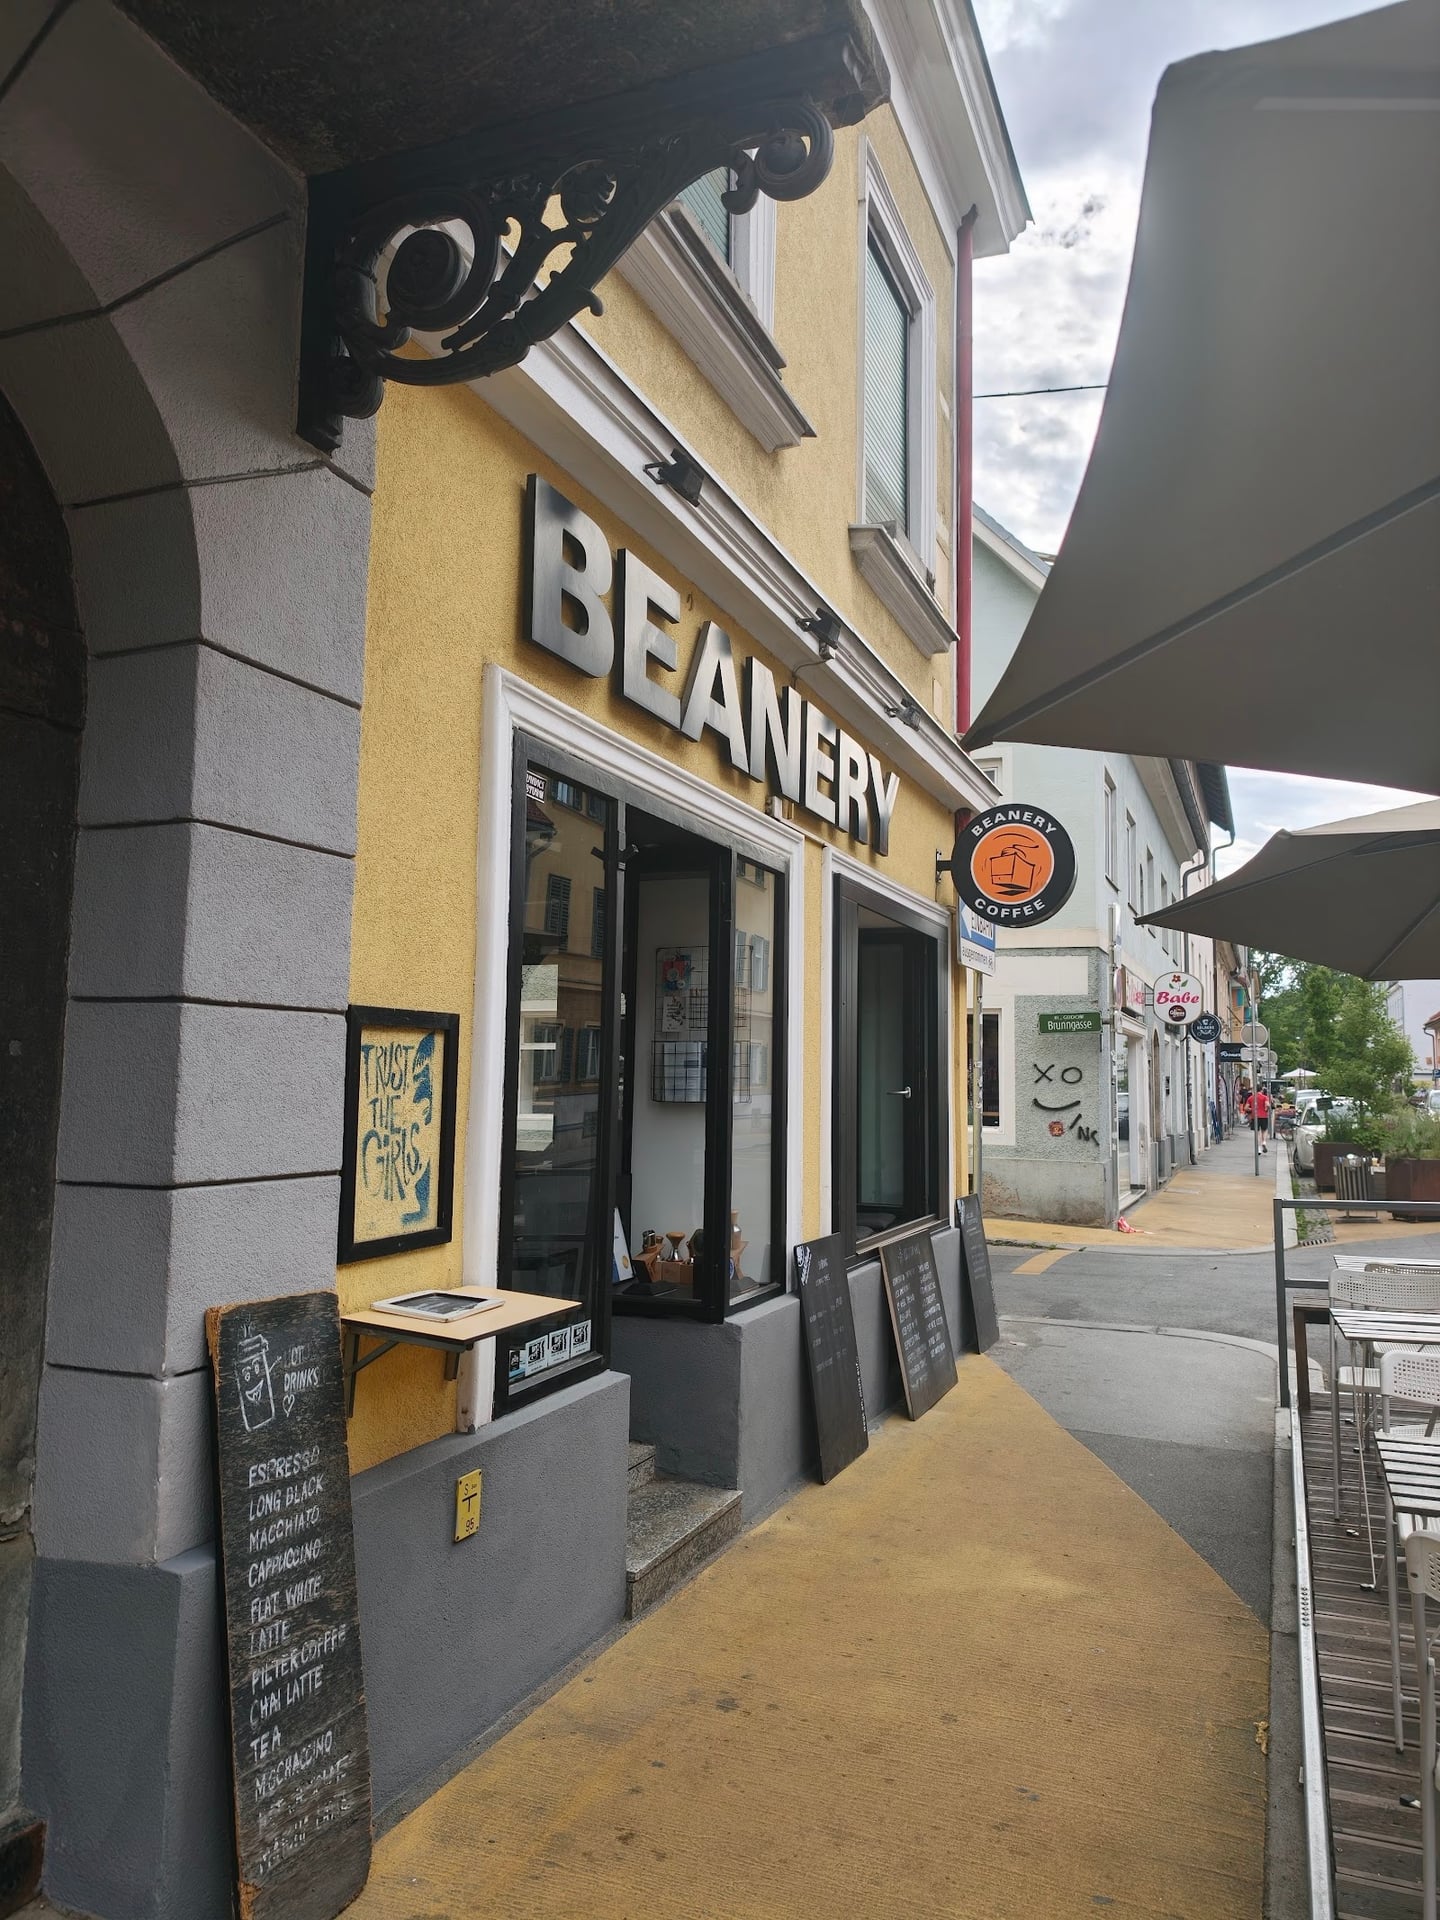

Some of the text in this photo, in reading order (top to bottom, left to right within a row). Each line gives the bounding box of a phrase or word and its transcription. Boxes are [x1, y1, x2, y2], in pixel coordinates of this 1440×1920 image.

[527, 472, 900, 857] BEANERY
[971, 810, 1057, 838] BEANERY
[974, 898, 1046, 918] COFFEE
[1157, 991, 1200, 1005] Babe
[1047, 1020, 1092, 1031] Brunngasse
[369, 1095, 401, 1134] THE
[284, 1366, 320, 1392] DRINKS
[248, 1446, 320, 1488] ESPRESSO
[249, 1474, 324, 1522] LONG BLACK
[249, 1506, 320, 1552] MACCHIATO
[248, 1538, 321, 1588] CAPPUCCINO
[251, 1575, 322, 1624] FLAT WHITE
[250, 1620, 291, 1656] LATTE
[252, 1647, 299, 1695] FILTER
[250, 1664, 324, 1726] CHAI LATTE
[250, 1725, 281, 1763] TEA
[255, 1730, 333, 1801] MOCHACCINO
